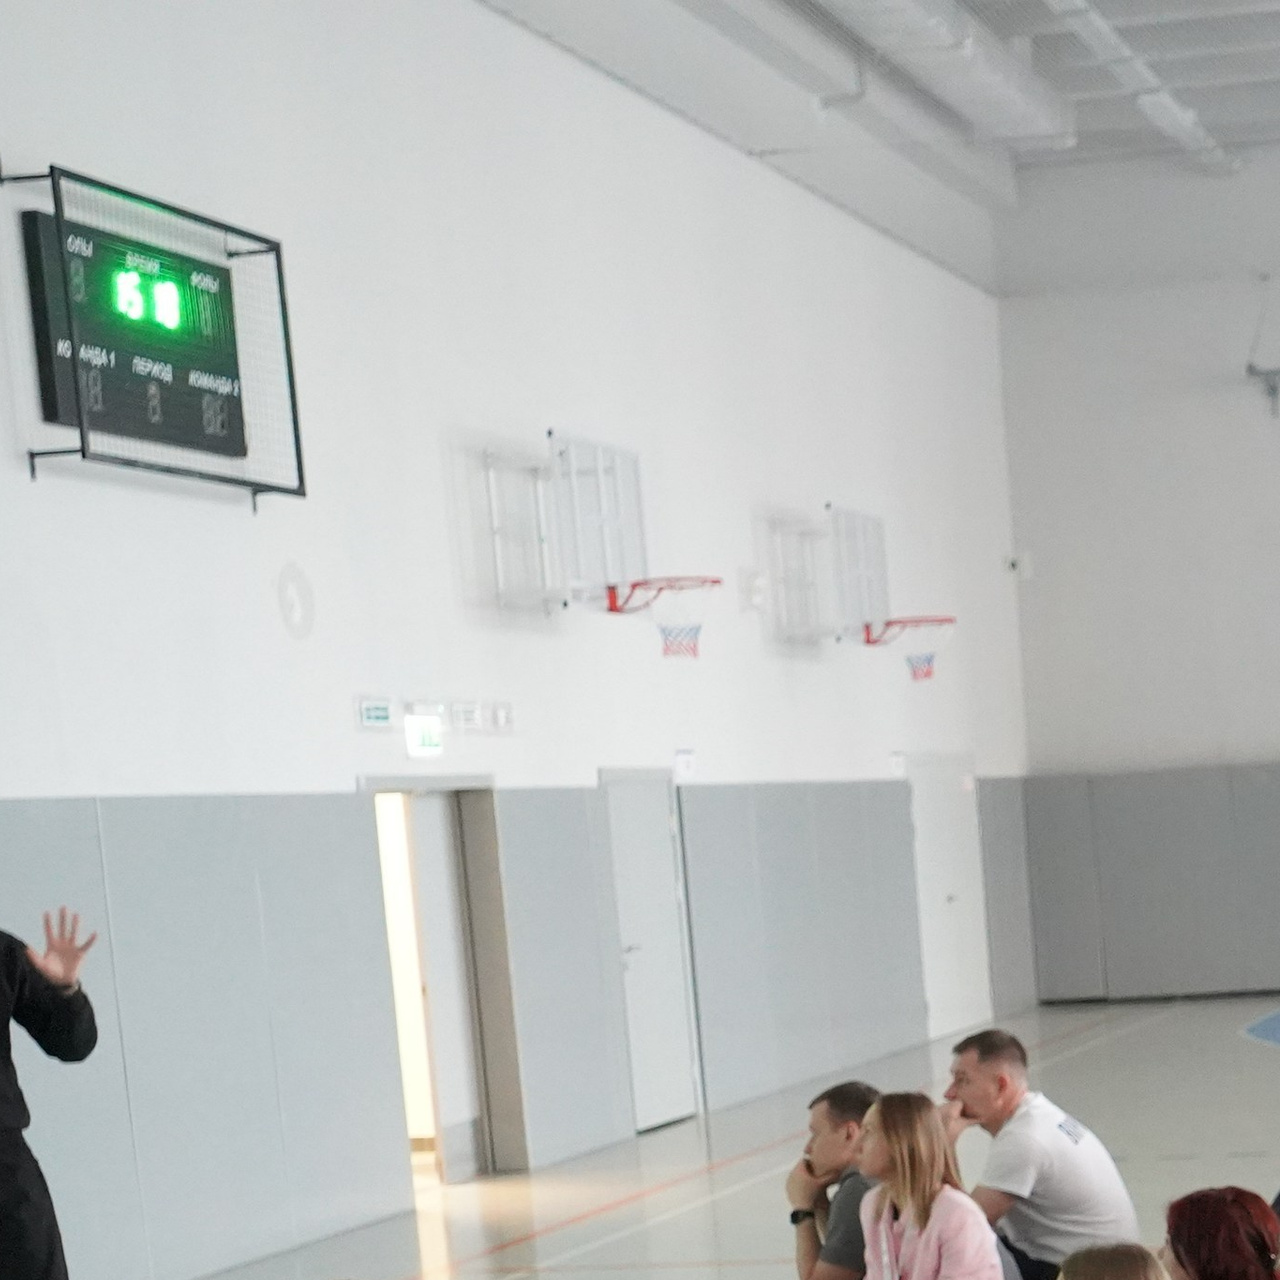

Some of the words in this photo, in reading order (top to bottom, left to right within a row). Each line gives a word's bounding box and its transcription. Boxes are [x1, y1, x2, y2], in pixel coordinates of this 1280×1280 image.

[56, 338, 108, 367] КОАНДА
[132, 355, 174, 384] ПЕРИОД
[188, 370, 233, 395] КОМАНДА
